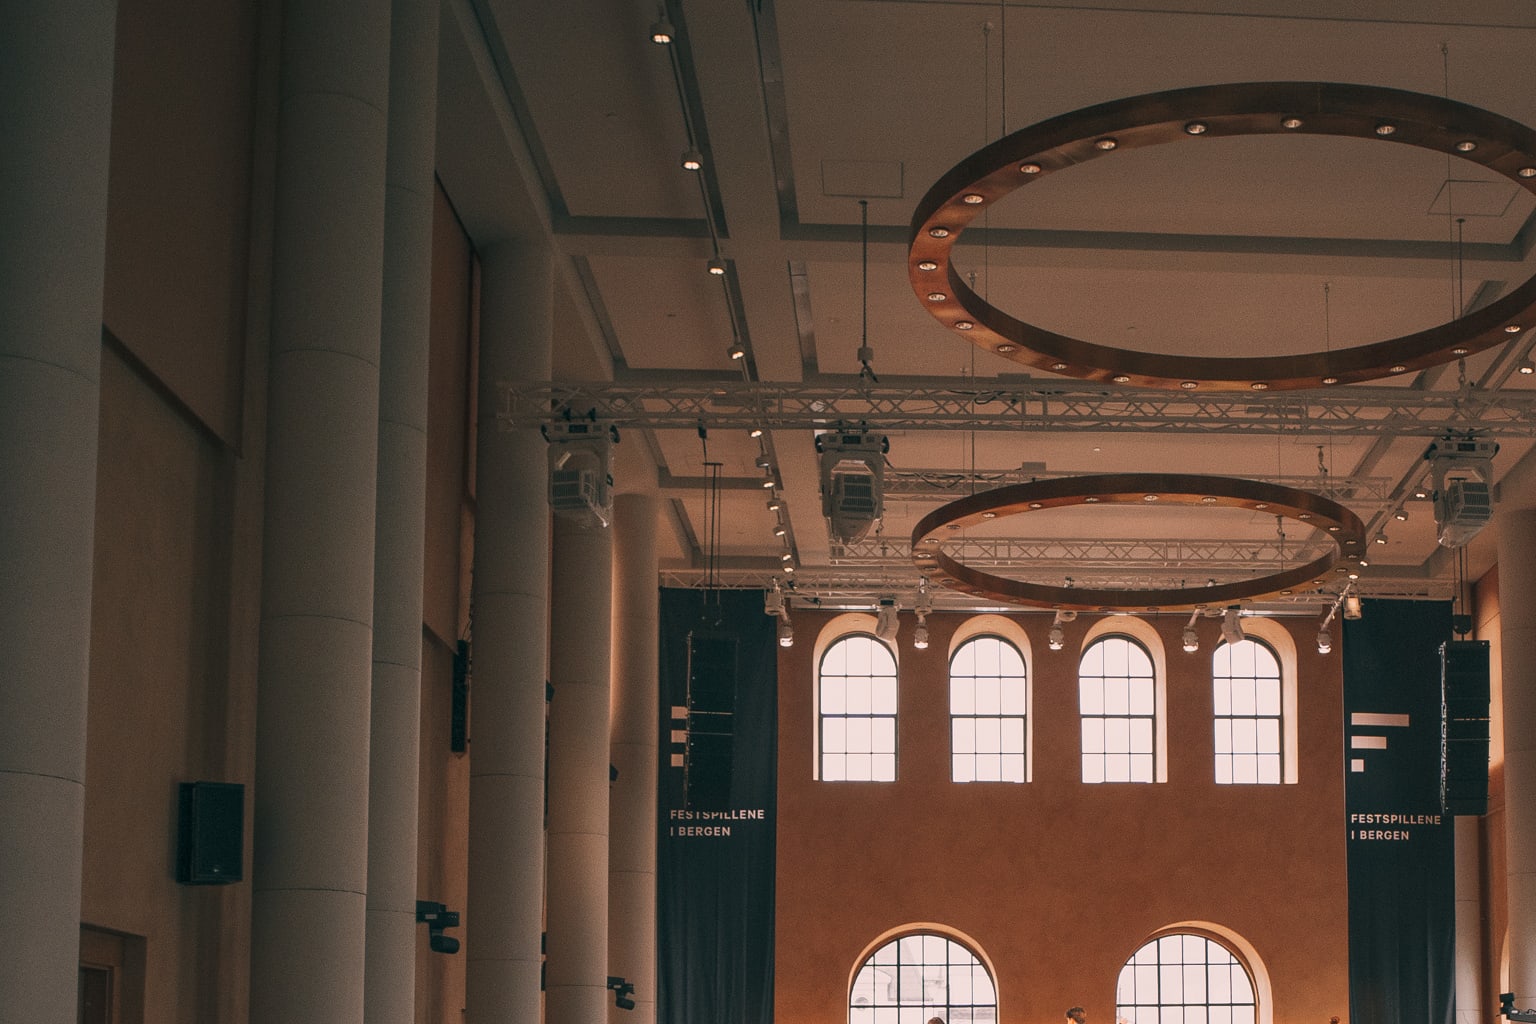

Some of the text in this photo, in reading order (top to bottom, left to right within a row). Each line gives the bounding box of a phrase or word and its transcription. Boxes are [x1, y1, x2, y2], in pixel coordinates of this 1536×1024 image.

[1351, 813, 1441, 825] FESTSPILLENE
[670, 826, 730, 836] I BERGEN
[1351, 830, 1409, 840] I BERGEN
